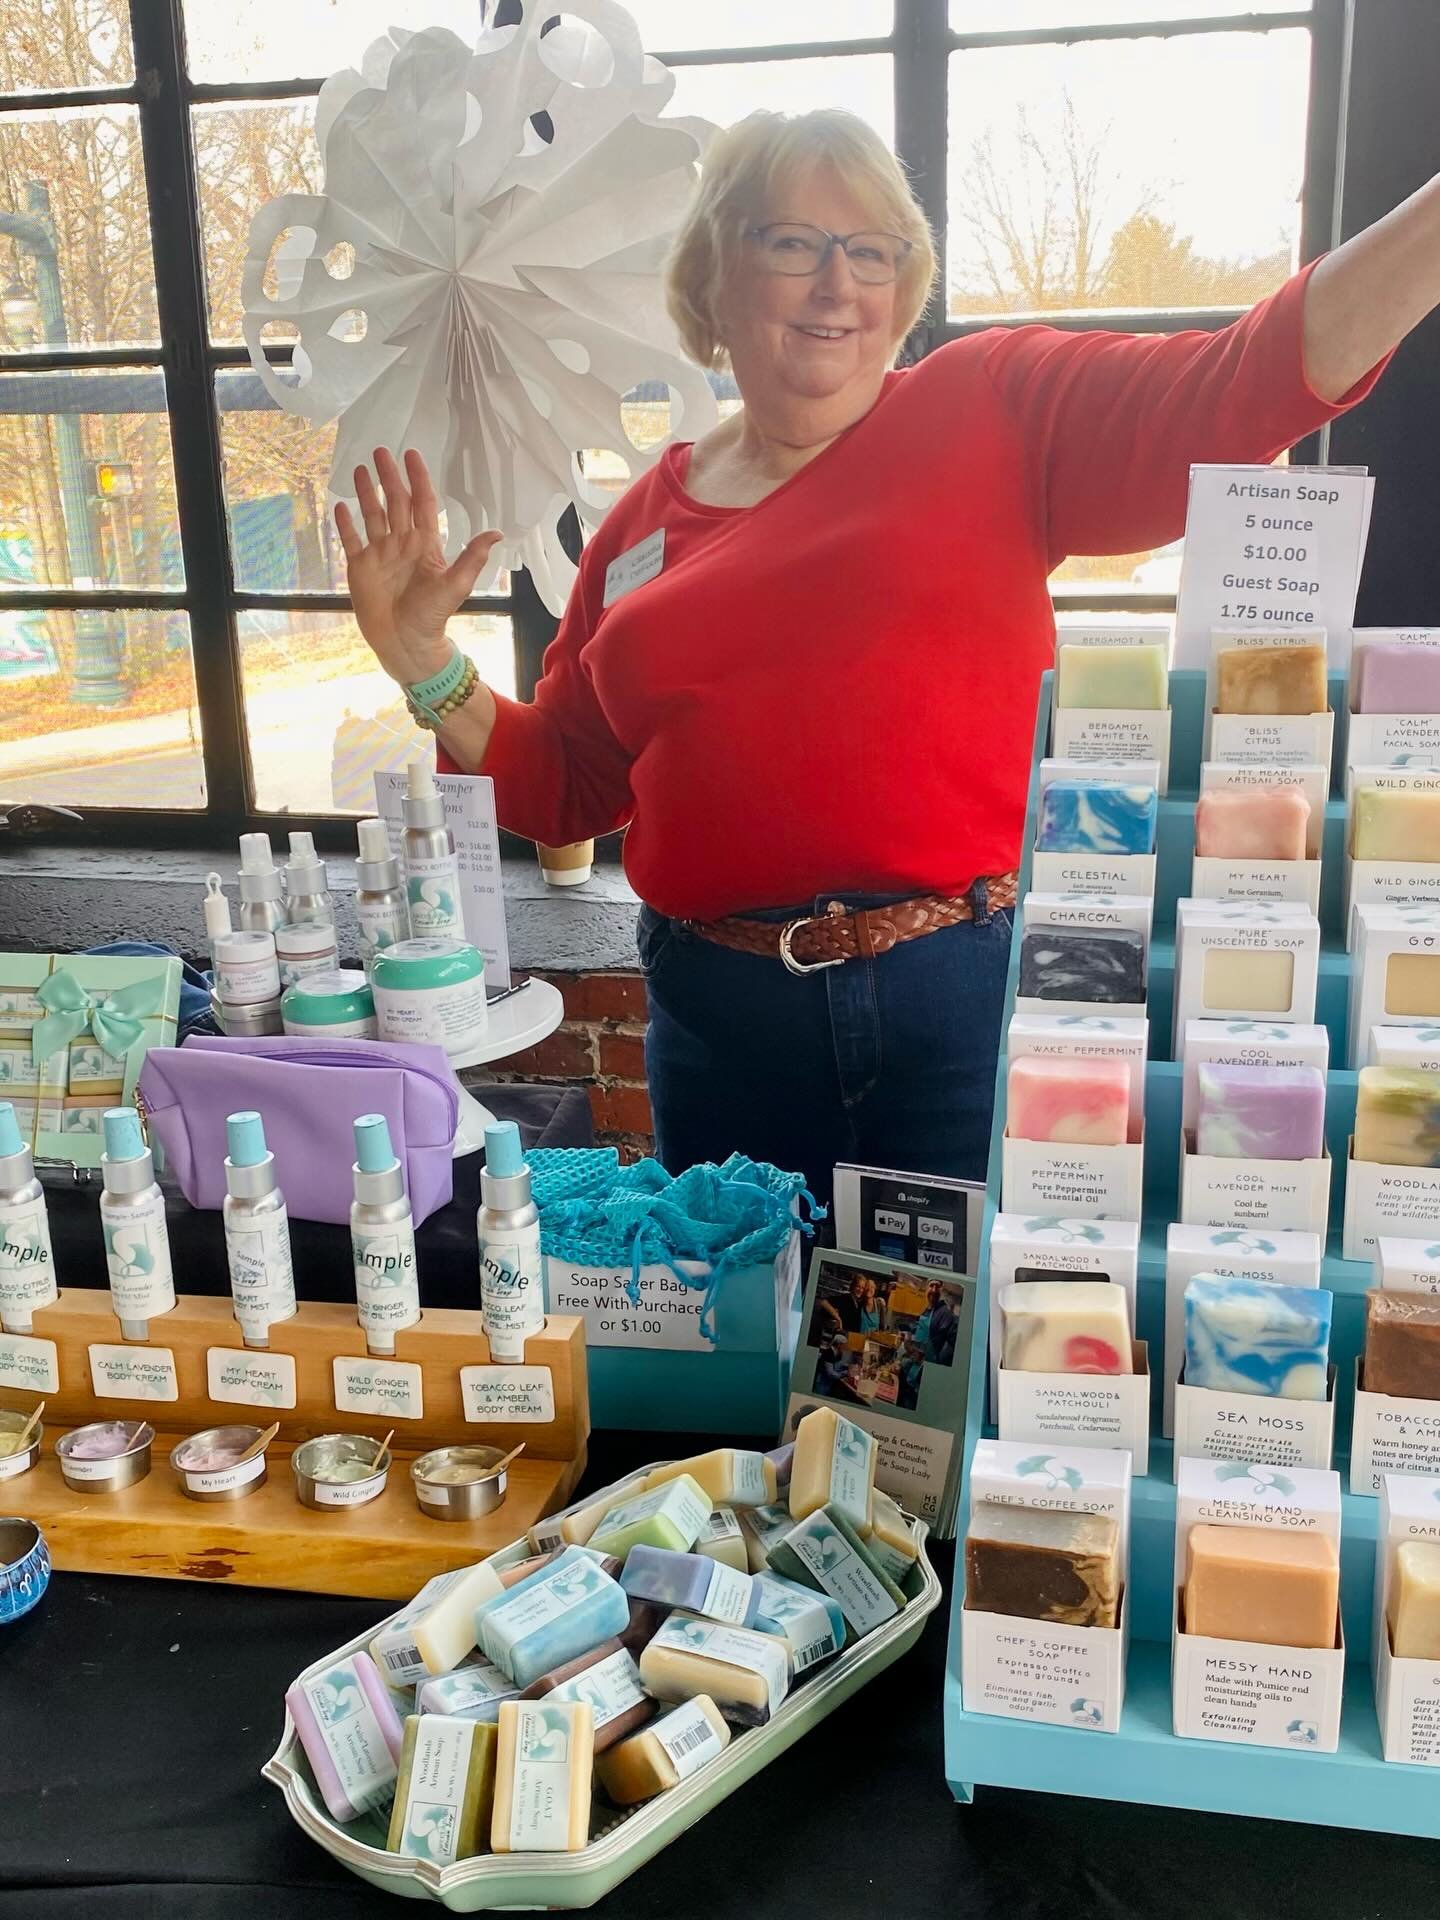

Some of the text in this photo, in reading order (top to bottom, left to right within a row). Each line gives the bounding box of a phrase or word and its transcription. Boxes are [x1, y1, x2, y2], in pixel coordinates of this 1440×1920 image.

[1227, 483, 1339, 503] Artisan Soap
[1245, 515, 1313, 531] 5 ounce
[1244, 544, 1306, 562] $10.00
[1223, 574, 1320, 594] Guest Soap
[1221, 605, 1314, 622] 1.75 ounce
[1089, 723, 1143, 731] BERGAMOT
[1245, 727, 1282, 735] "BLISS"
[1376, 780, 1406, 788] WILD
[1062, 870, 1127, 881] CELESTIAL
[1229, 873, 1287, 882] MY HEART
[1374, 878, 1402, 886] WILD
[1050, 912, 1122, 922] CHARCOAL
[1233, 928, 1272, 938] "PURE"
[1201, 938, 1305, 948] UNSCENTED SOAP
[1028, 1044, 1143, 1056] "WAKE" PEPPERMINT
[1240, 1049, 1272, 1058] COOL
[1047, 1160, 1089, 1170] "WAKE"
[1032, 1170, 1104, 1182] PEPPERMINT
[1236, 1174, 1265, 1183] COOL
[1032, 1183, 1107, 1195] Pure Peppermint
[1208, 1183, 1298, 1193] LAVENDER MINT
[907, 1194, 930, 1205] shopify
[1042, 1192, 1099, 1203] Essential Oil
[1378, 1192, 1402, 1200] Enjoy
[1234, 1200, 1268, 1209] Cool the
[1233, 1209, 1269, 1218] sunburn!
[887, 1217, 905, 1230] Pay
[933, 1225, 950, 1237] Pay
[237, 1250, 265, 1267] Sample
[923, 1253, 949, 1266] VISA
[1023, 1253, 1090, 1264] SANDALWOOD
[1035, 1261, 1089, 1270] PATCHOULI
[1214, 1268, 1274, 1280] SEA MOSS
[571, 1273, 608, 1291] Soap
[660, 1279, 688, 1296] Bag
[504, 1304, 526, 1312] LEAF
[558, 1294, 703, 1315] Free With Purchace
[600, 1318, 662, 1334] or $1.00
[18, 1355, 48, 1366] CITRUS
[18, 1365, 49, 1376] CREAM
[97, 1361, 172, 1374] CALM LAVENDER
[225, 1367, 277, 1379] MY HEART
[106, 1371, 168, 1383] BODY CREAM
[347, 1375, 409, 1388] WILD GINGER
[220, 1376, 284, 1391] BODY CREAM
[470, 1384, 544, 1392] TOBACCO LEAF
[347, 1386, 410, 1399] BODY CREAM
[497, 1394, 530, 1402] AMBER
[476, 1405, 543, 1414] BODY CREAM
[1047, 1399, 1110, 1409] PATCHOULI
[1217, 1411, 1304, 1431] SEA MOSS
[1376, 1413, 1440, 1426] TOBACCO
[1039, 1422, 1121, 1433] Patchouli, Cedarwood
[871, 1431, 933, 1454] Soap & Cosmetic
[1373, 1439, 1428, 1452] Warm honey
[878, 1445, 896, 1456] From
[898, 1450, 927, 1464] Claudia
[1373, 1450, 1396, 1458] notes
[890, 1460, 909, 1474] Soap
[912, 1467, 931, 1480] Lady
[1372, 1460, 1393, 1468] hints
[1407, 1463, 1431, 1472] citrus
[201, 1475, 236, 1488] My Heart
[332, 1487, 375, 1500] Wild Ginger
[985, 1493, 1114, 1512] CHEF'S COFFEE SOAP
[1212, 1499, 1302, 1516] MESSY HAND
[1198, 1507, 1316, 1527] CLEANSING SOAP
[1029, 1650, 1059, 1659] SOAP
[1044, 1643, 1088, 1655] COFFEE
[997, 1657, 1090, 1678] Expresso Coffee
[1206, 1659, 1312, 1679] MESSY HAND
[1035, 1673, 1079, 1685] grounds
[1206, 1674, 1231, 1684] Made
[1234, 1678, 1253, 1687] with
[1256, 1681, 1289, 1692] Pumice
[986, 1684, 1033, 1696] Eliminates
[1205, 1686, 1261, 1700] moisturizing
[1265, 1693, 1280, 1701] oils
[984, 1692, 1009, 1700] onion
[1032, 1699, 1057, 1708] garlic
[1204, 1696, 1257, 1709] clean hands
[1009, 1703, 1034, 1712] odors
[1201, 1712, 1256, 1725] Exfoliating
[1203, 1720, 1253, 1733] Cleansing
[419, 1739, 432, 1784] Woodlands
[430, 1737, 445, 1790] Artisan Soap
